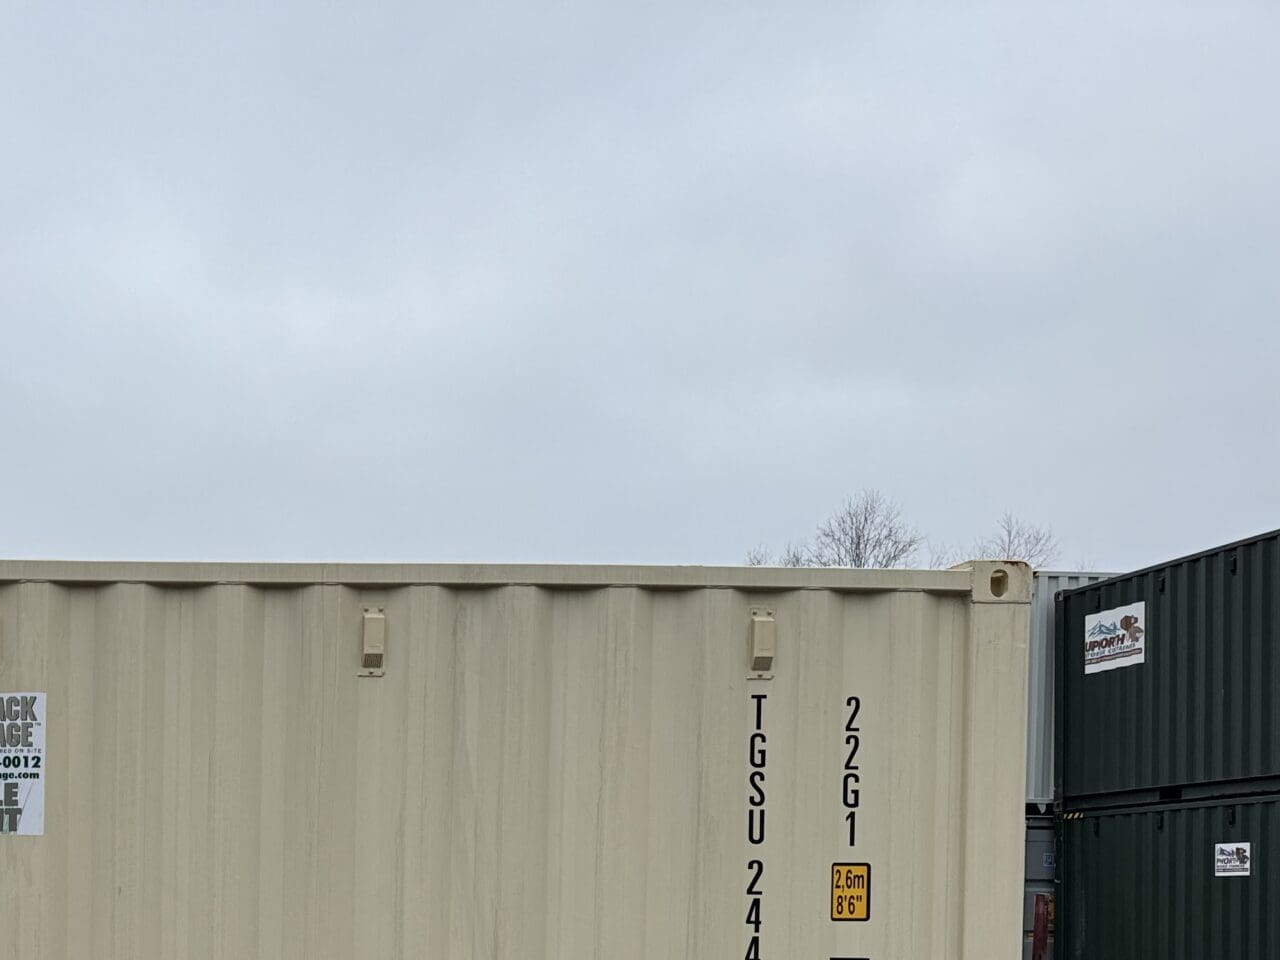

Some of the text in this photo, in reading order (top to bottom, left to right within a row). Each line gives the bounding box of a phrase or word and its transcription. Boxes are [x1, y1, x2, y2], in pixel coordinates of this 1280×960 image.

[749, 694, 767, 844] TGSU
[842, 696, 861, 846] 22G1
[836, 895, 862, 915] 8'6"
